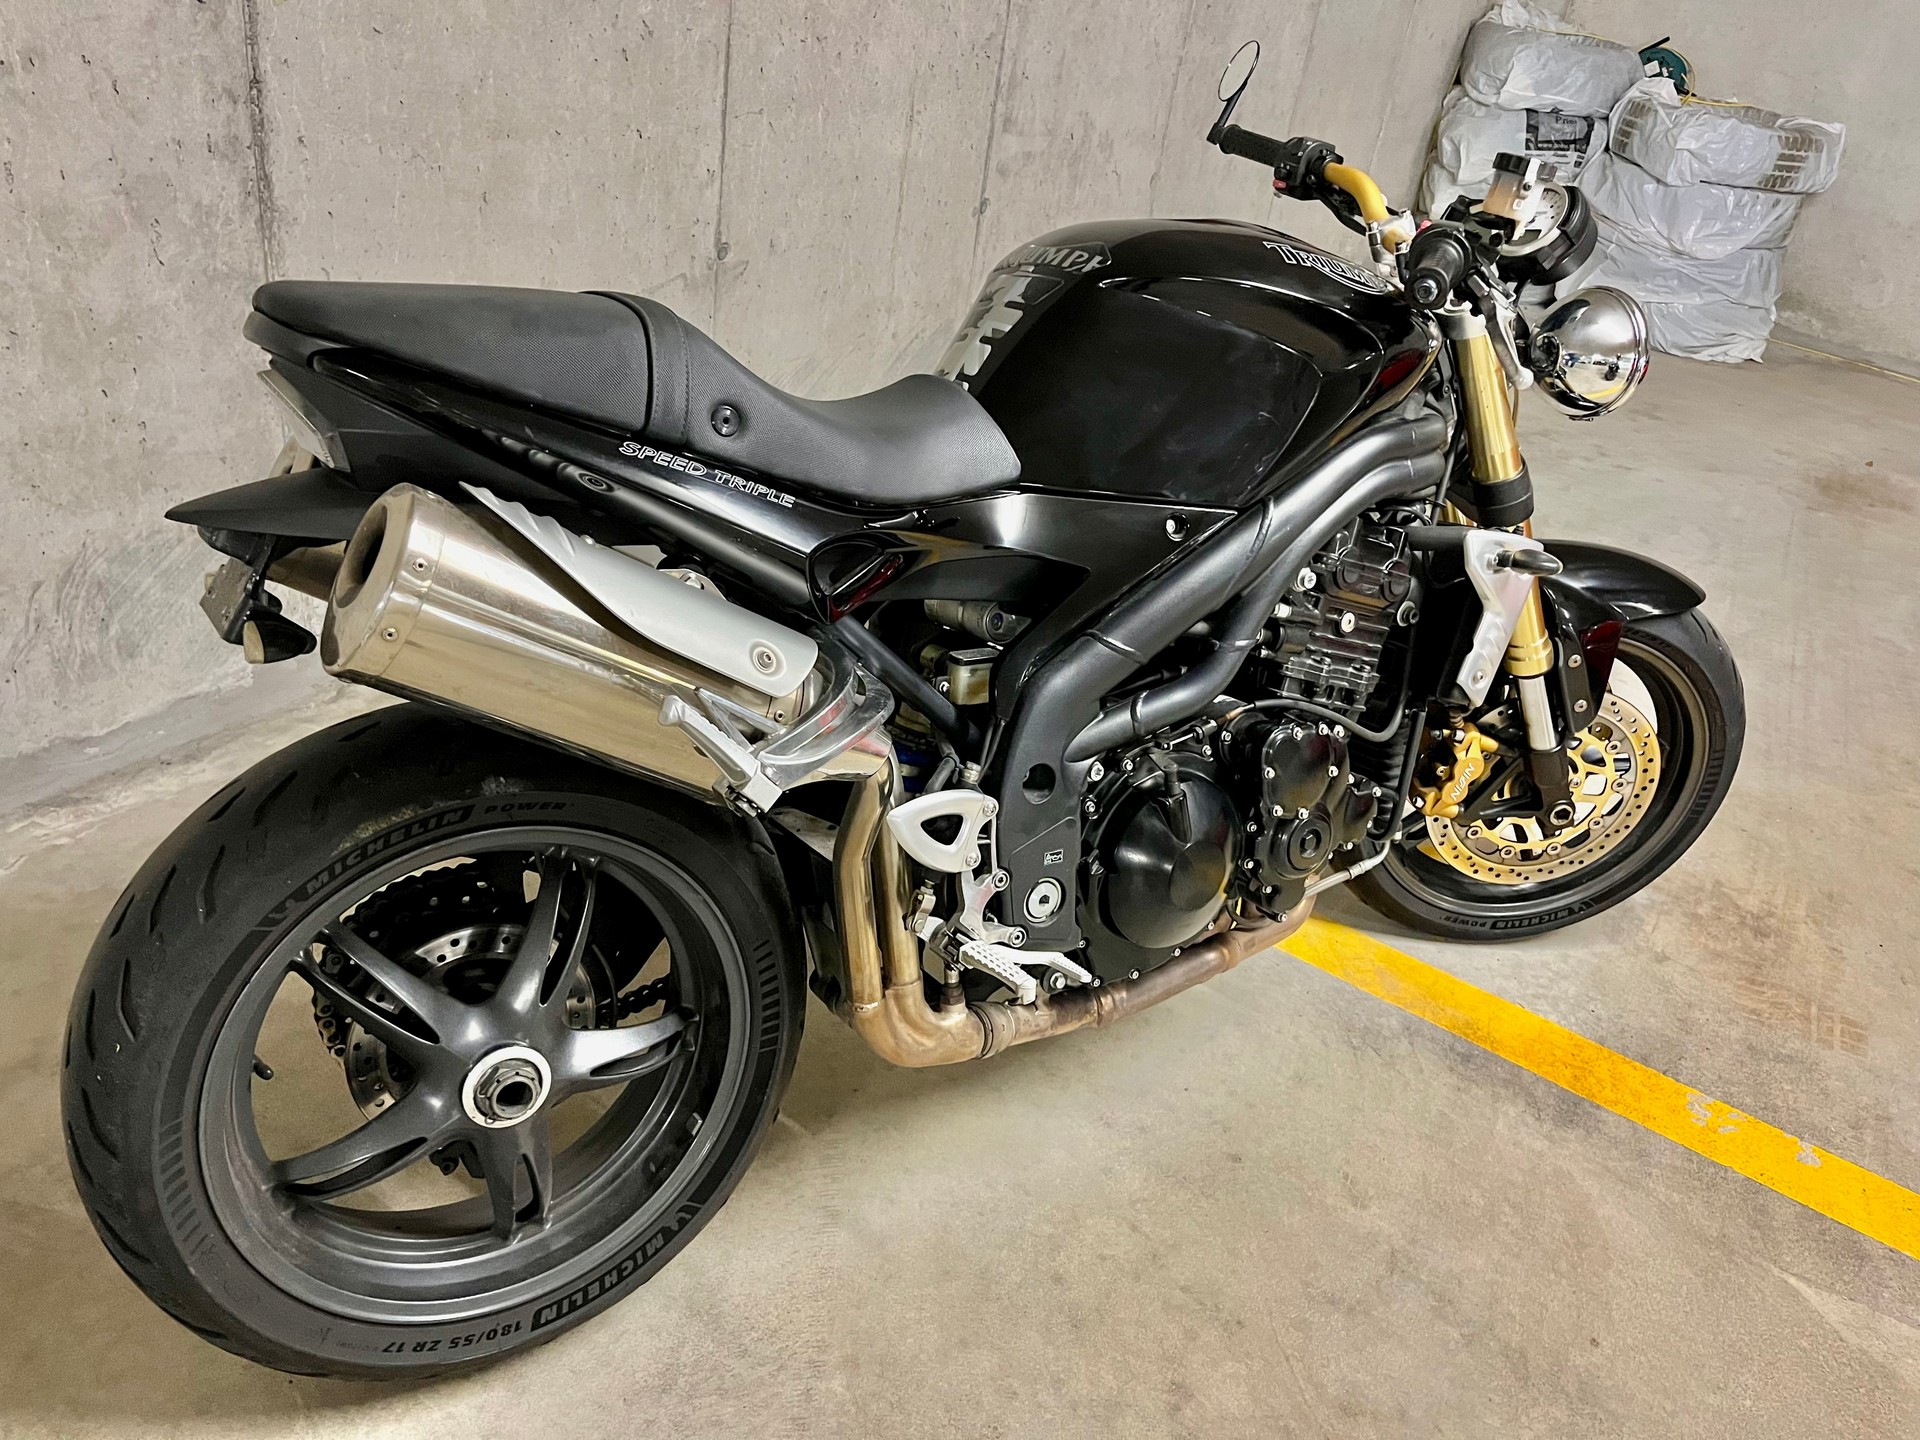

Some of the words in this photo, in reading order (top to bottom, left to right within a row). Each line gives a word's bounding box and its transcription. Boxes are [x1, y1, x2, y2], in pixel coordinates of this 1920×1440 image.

[1262, 241, 1388, 294] TRIUM
[619, 441, 707, 476] SPEED
[714, 470, 796, 508] TRIPLE
[306, 806, 466, 895] MICHELIN
[483, 801, 567, 815] POWER
[1444, 915, 1488, 928] POWER
[1494, 908, 1570, 929] MICHELIN
[539, 1235, 665, 1324] MICHELIN
[381, 1341, 405, 1354] 17
[412, 1338, 446, 1353] ZR
[447, 1321, 523, 1349] 180/55
